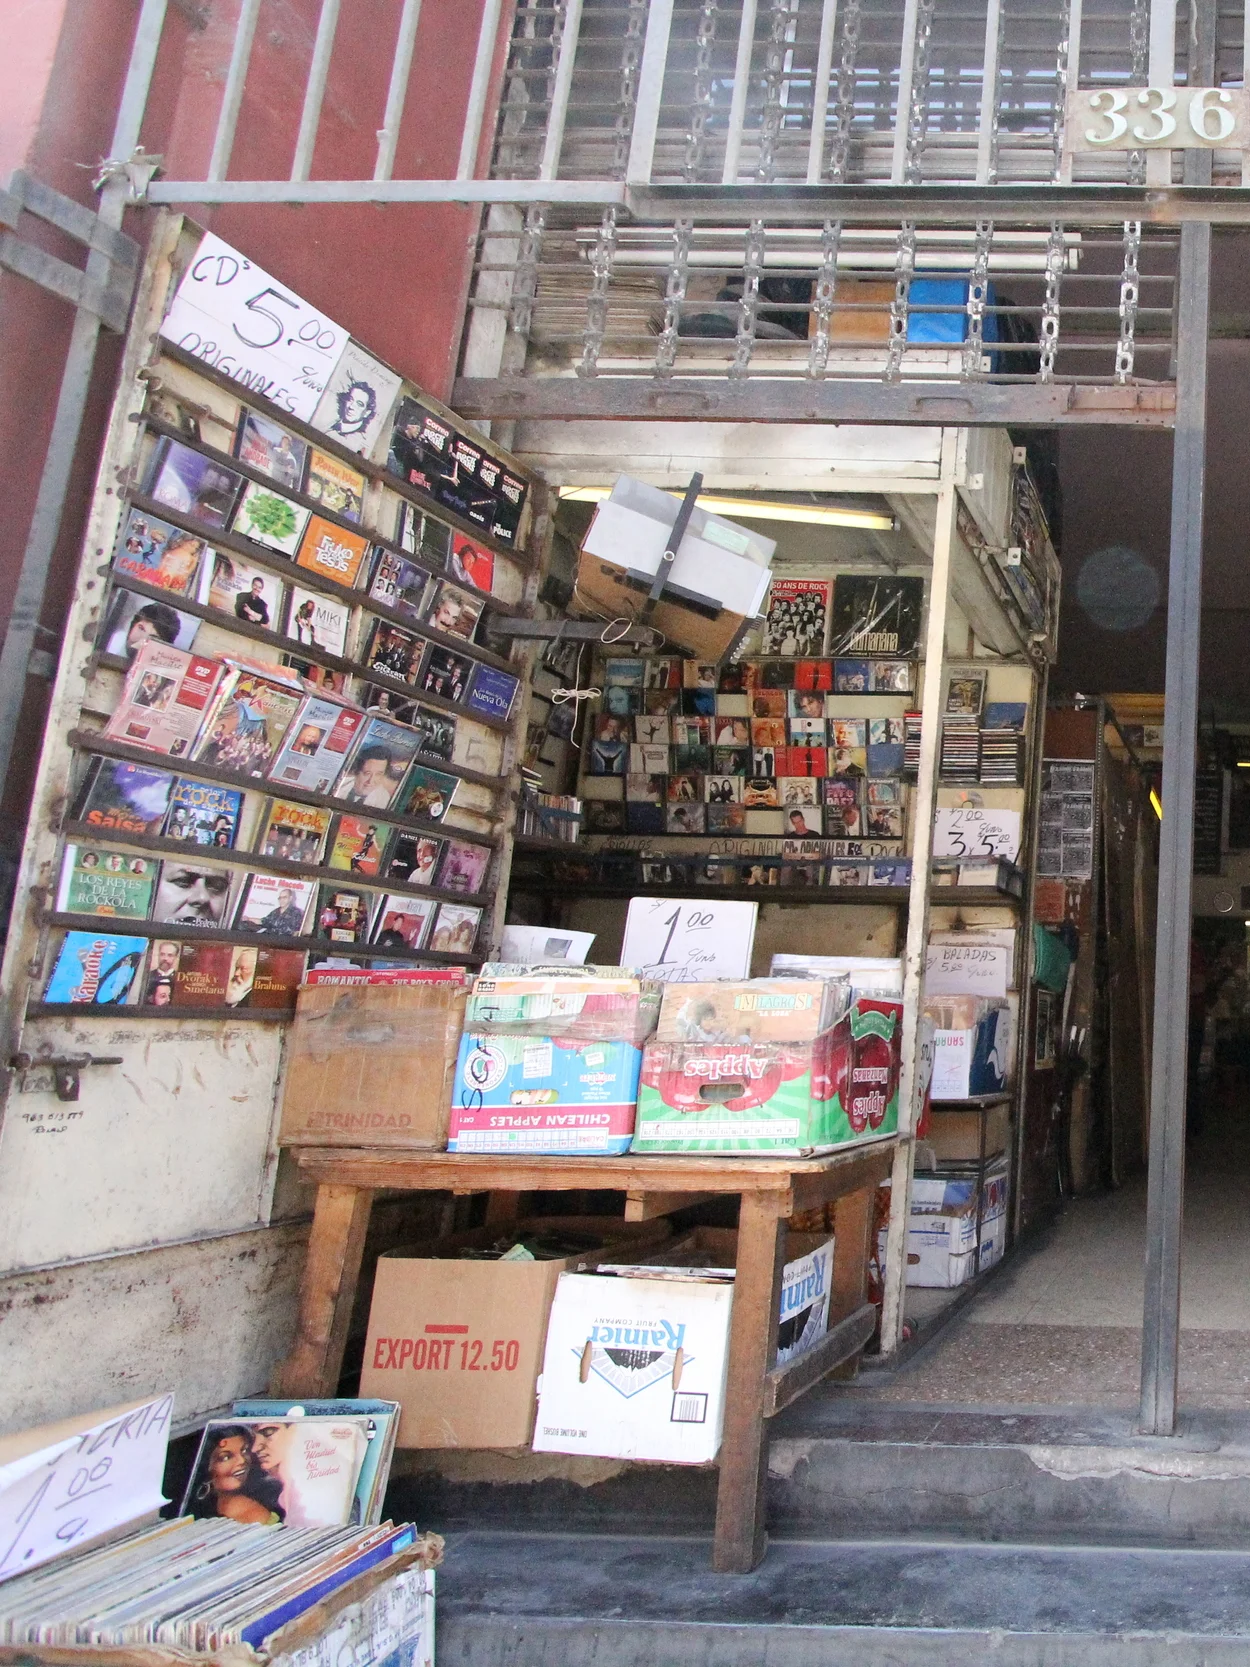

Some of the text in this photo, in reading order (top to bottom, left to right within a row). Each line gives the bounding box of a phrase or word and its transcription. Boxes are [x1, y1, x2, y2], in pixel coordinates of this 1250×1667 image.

[1085, 87, 1236, 143] 336
[178, 332, 300, 413] ORIGINALES
[469, 511, 485, 522] oasis
[493, 526, 512, 539] POLICE
[782, 582, 797, 590] ANS
[798, 582, 808, 590] DE
[809, 583, 829, 591] ROCK
[316, 607, 342, 627] MIKI
[472, 688, 494, 704] Nueva
[495, 698, 508, 709] Ola
[174, 785, 235, 811] rock
[87, 809, 147, 833] Salsa
[274, 805, 326, 830] rock
[946, 831, 966, 857] 3
[79, 874, 142, 891] LOS REYES
[92, 885, 127, 897] DE LA
[77, 892, 137, 909] ROCKOLA
[943, 948, 997, 962] BALADAS
[254, 980, 287, 991] Brahms
[317, 975, 372, 985] ROMANTIC
[184, 984, 225, 995] Smetana
[684, 1054, 767, 1079] Apples
[853, 1067, 888, 1084] Manzanas
[853, 1090, 886, 1117] Apples
[325, 1112, 412, 1129] TRINIDAD
[489, 1112, 611, 1127] CHILEAN APPLES
[594, 1318, 632, 1326] COMPANY
[586, 1320, 686, 1351] Rainier
[373, 1338, 519, 1372] EXPORT 12.50
[304, 1447, 337, 1460] Madrid
